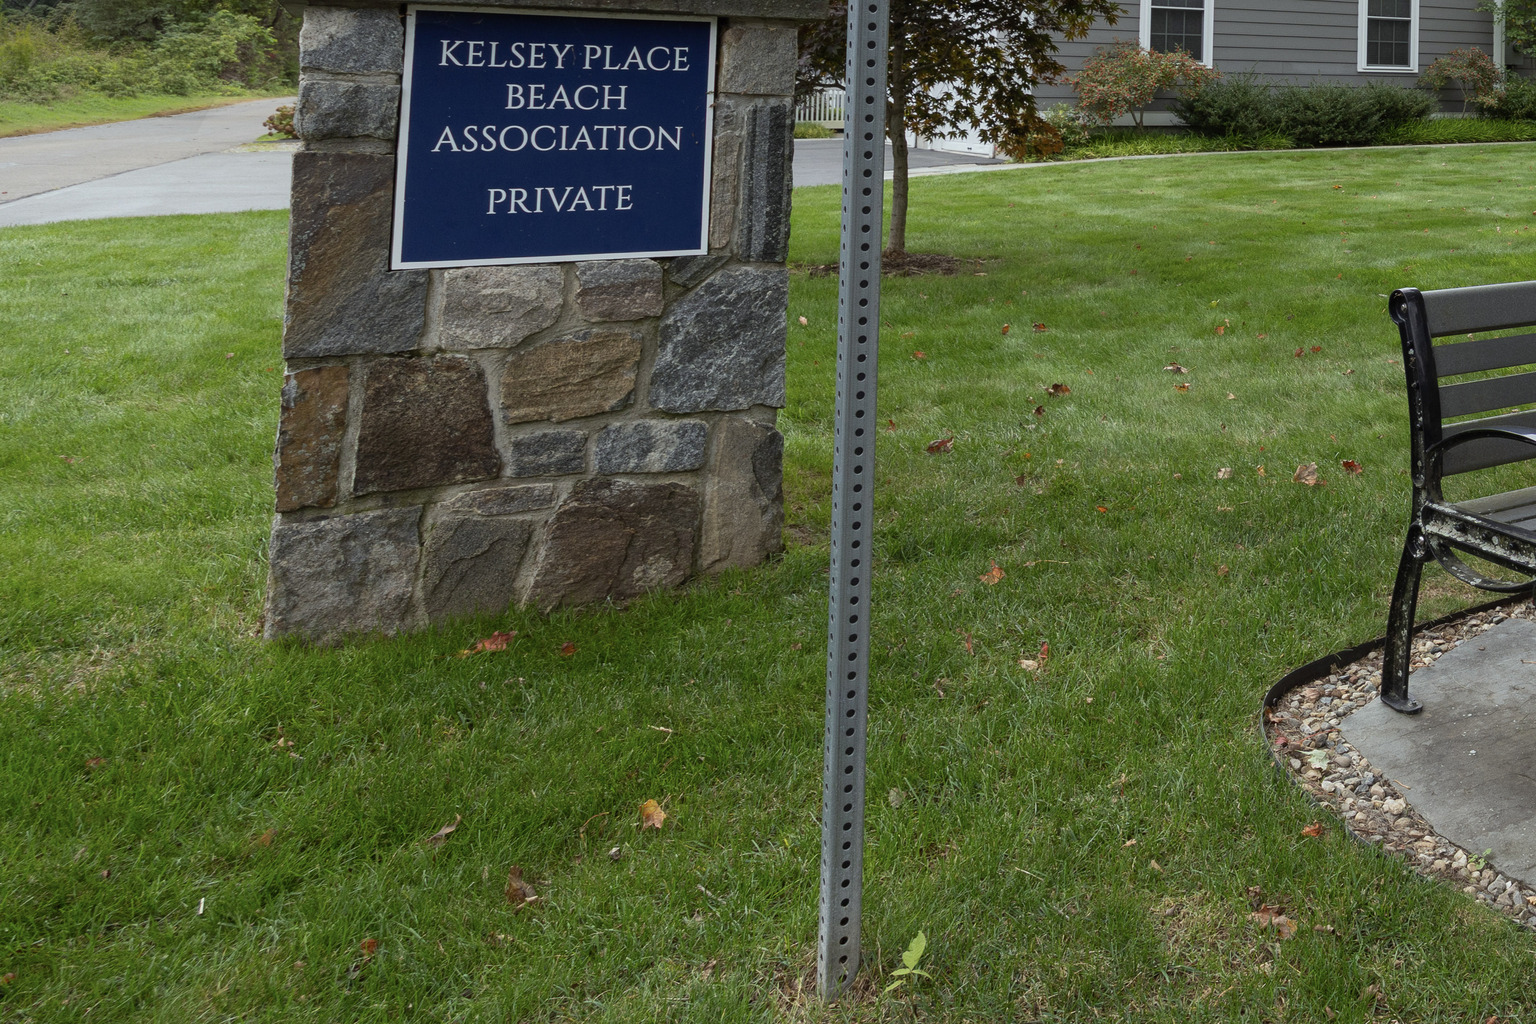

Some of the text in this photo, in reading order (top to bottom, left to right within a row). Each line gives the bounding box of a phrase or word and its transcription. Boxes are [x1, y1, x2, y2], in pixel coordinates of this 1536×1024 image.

[438, 39, 690, 72] KELSEY PLACE
[504, 83, 628, 111] BEACH
[430, 124, 684, 153] ASSOCIATION
[486, 184, 634, 215] PRIVATE
